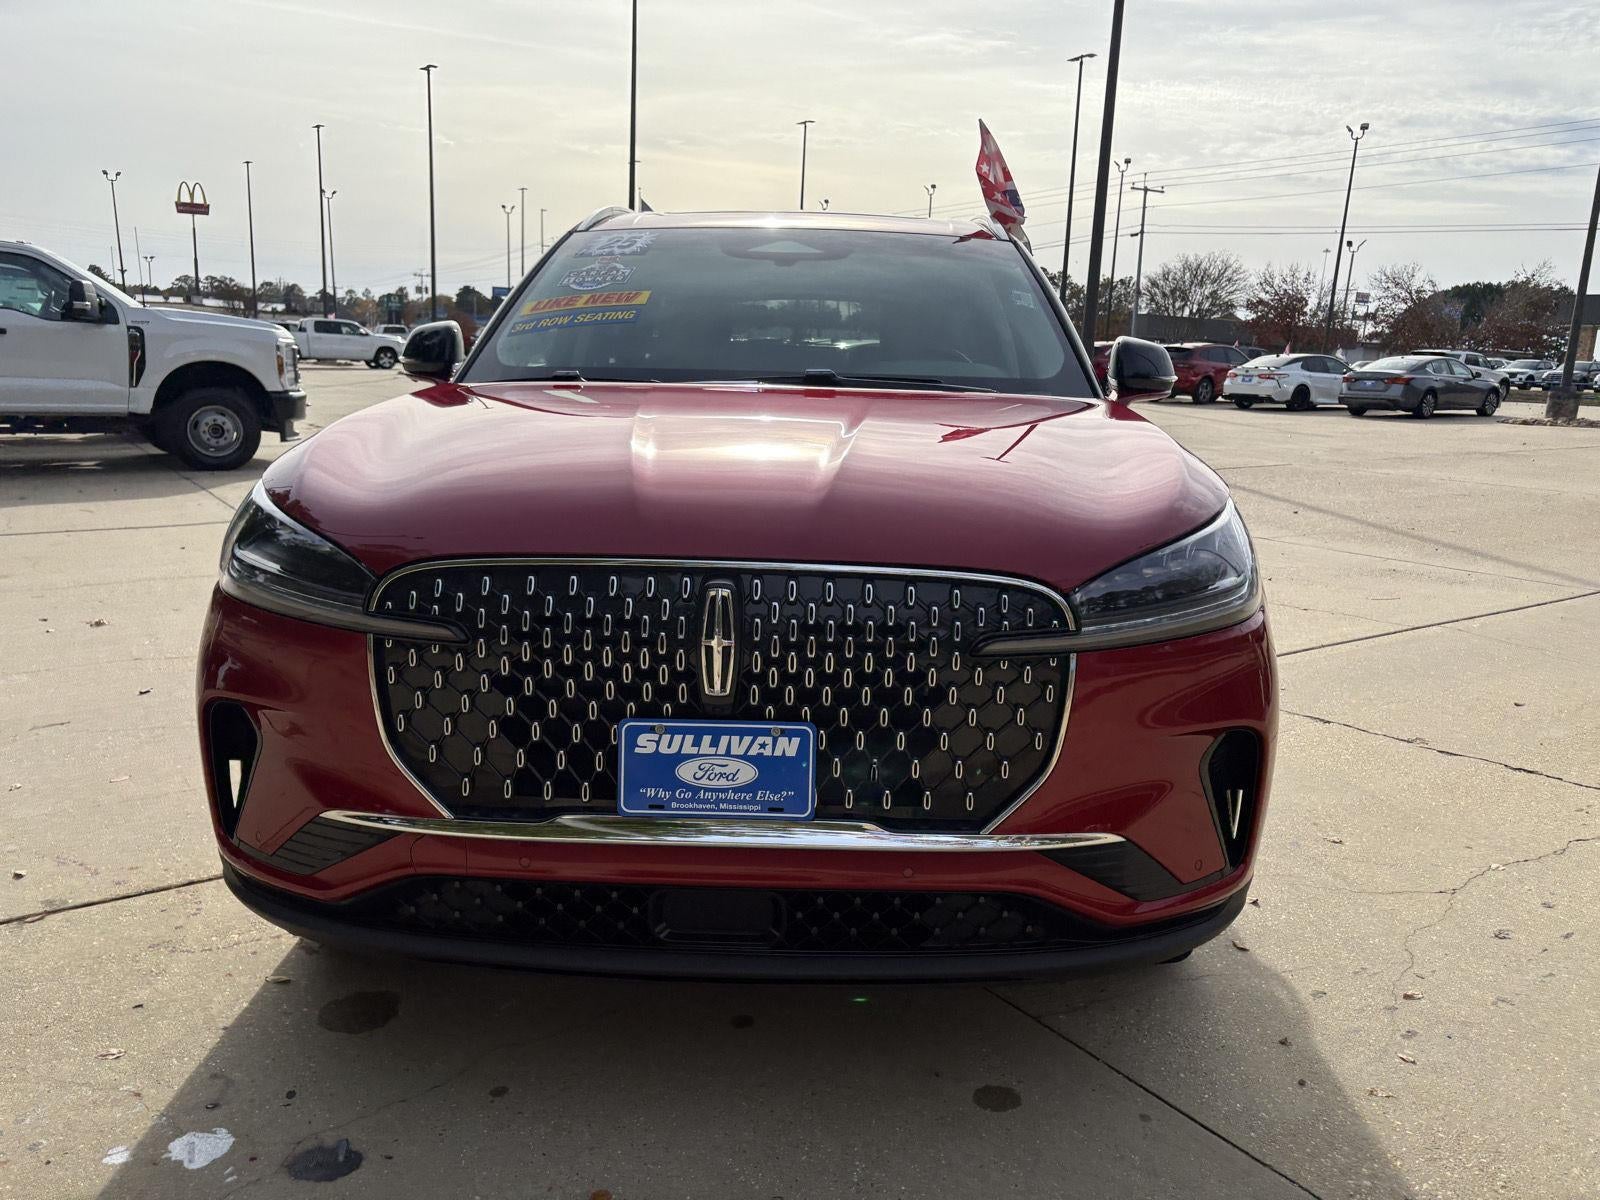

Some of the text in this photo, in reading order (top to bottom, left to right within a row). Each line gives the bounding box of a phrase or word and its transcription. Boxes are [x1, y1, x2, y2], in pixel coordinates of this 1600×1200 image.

[529, 292, 640, 313] LIKE NEW
[511, 310, 636, 333] 3rd ROW SEATING
[634, 733, 800, 757] SULLIVAN
[693, 762, 740, 782] Ford
[675, 788, 692, 799] Go
[695, 789, 752, 802] Anywhere
[671, 801, 761, 811] Brookhaven, Mississippi
